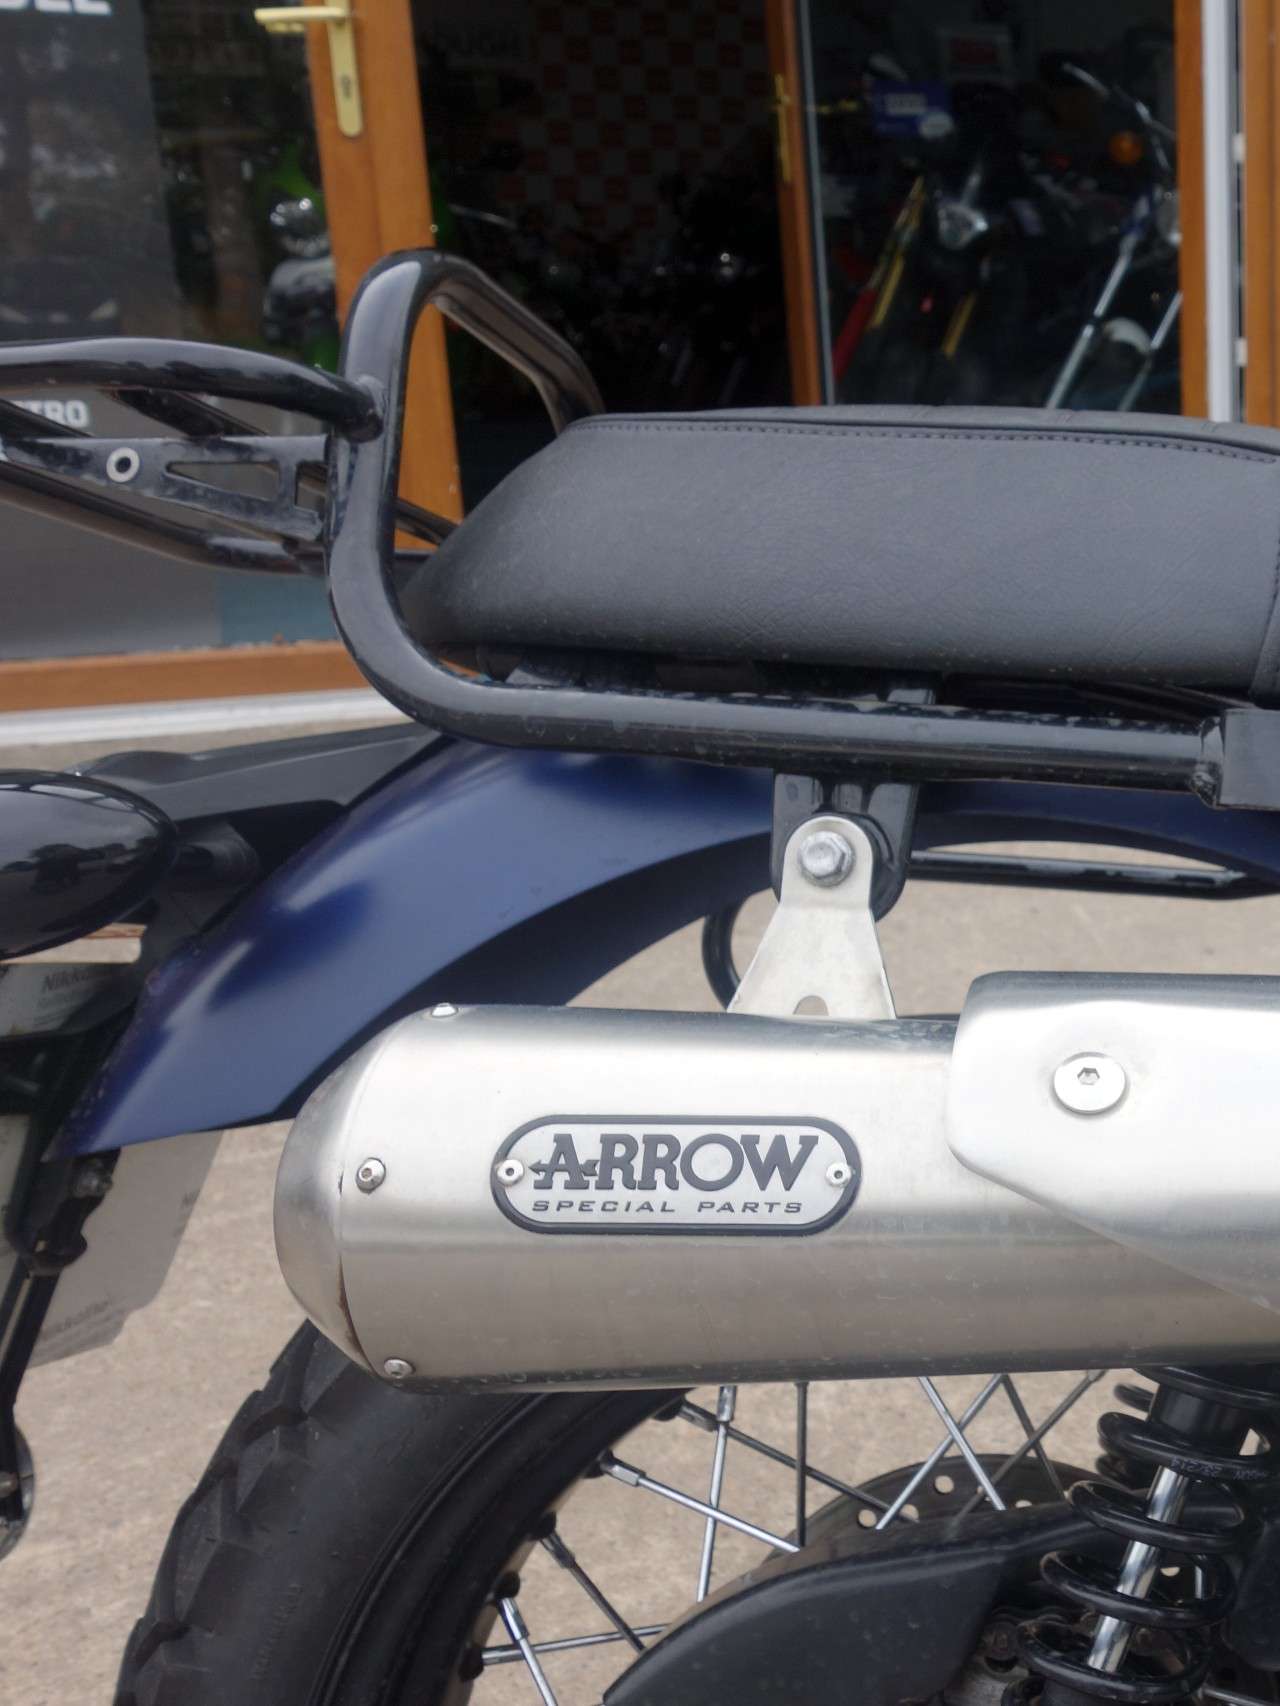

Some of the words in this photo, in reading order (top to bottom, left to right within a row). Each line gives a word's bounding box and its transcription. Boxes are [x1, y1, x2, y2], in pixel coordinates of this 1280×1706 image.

[532, 1133, 819, 1192] ARROW
[532, 1200, 676, 1213] SPECIAL
[697, 1201, 803, 1214] PARTS
